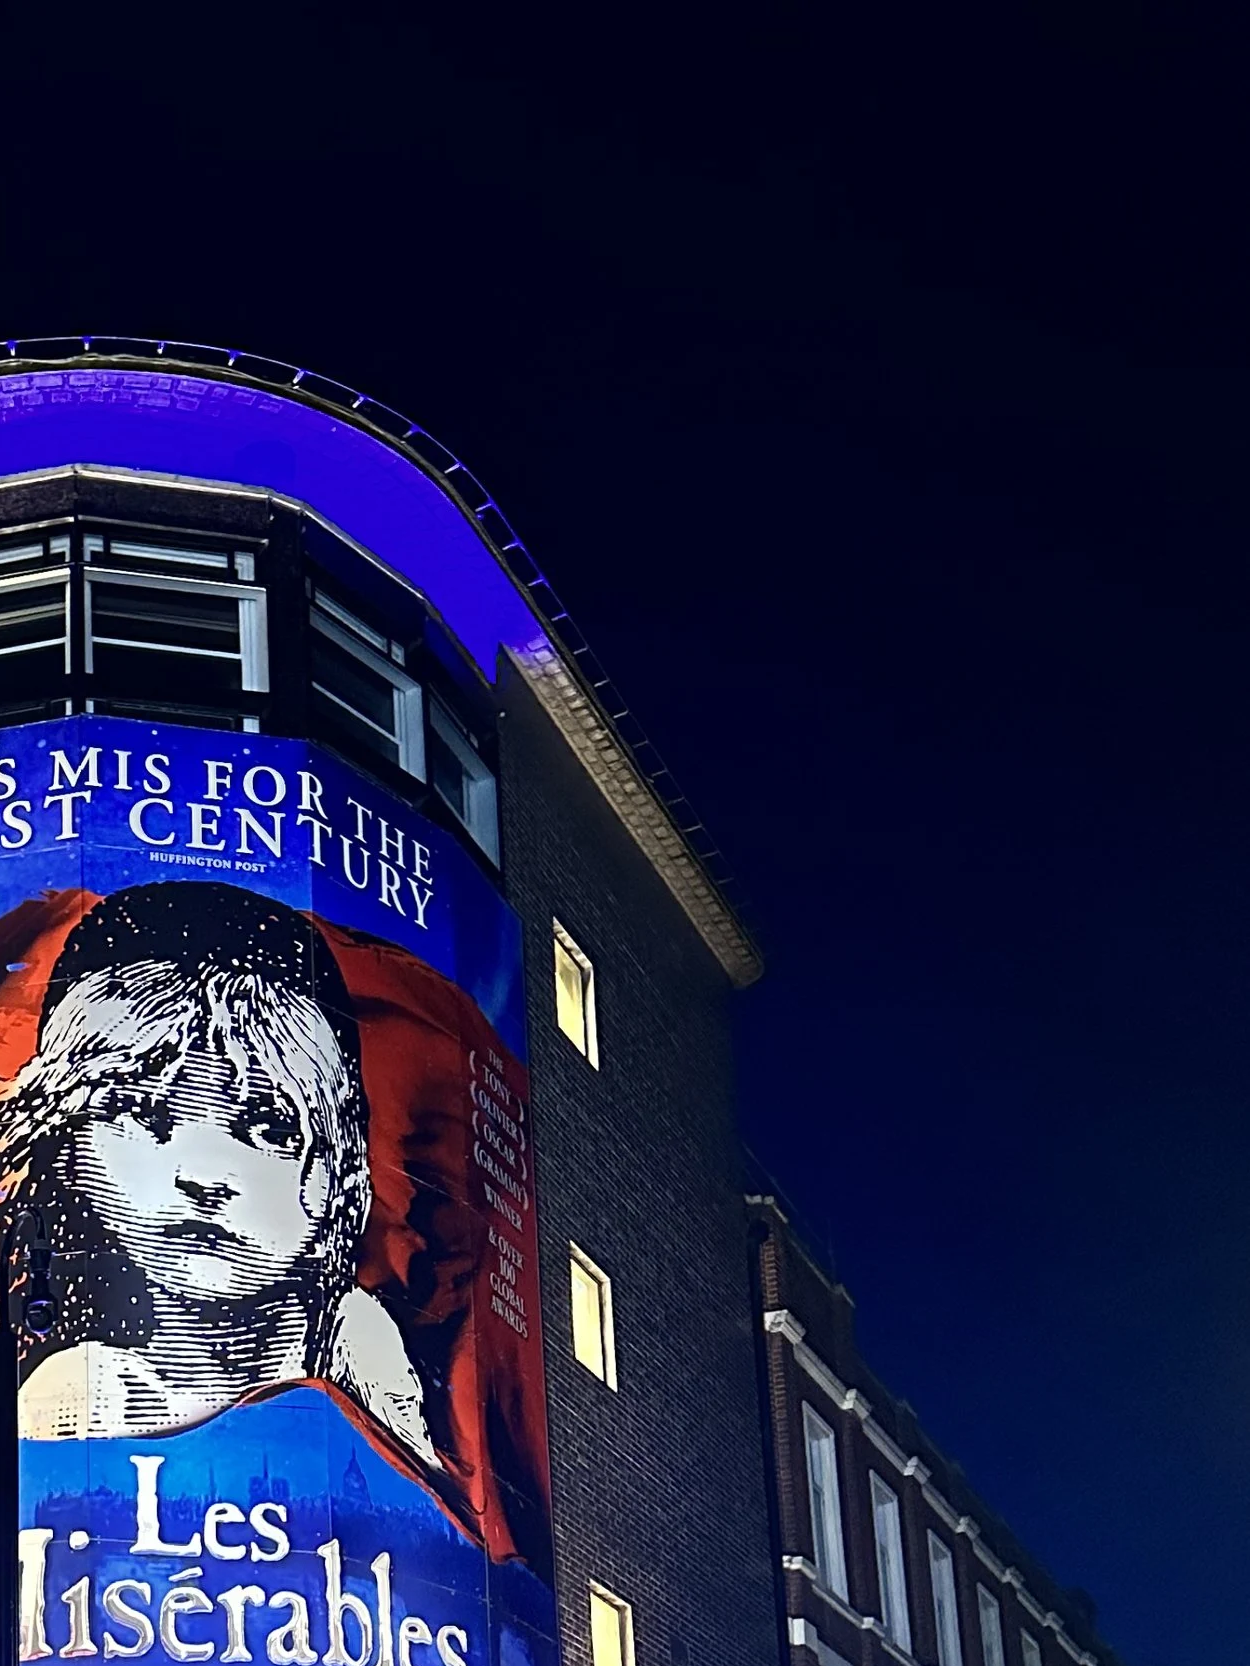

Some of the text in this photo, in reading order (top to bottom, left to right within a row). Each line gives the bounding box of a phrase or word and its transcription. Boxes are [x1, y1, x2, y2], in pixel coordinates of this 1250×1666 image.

[48, 746, 171, 795] MIS
[203, 759, 328, 820] FOR
[347, 797, 434, 885] THE
[128, 797, 434, 930] CENTURY
[149, 851, 268, 874] HUFFINGTON POST
[488, 1047, 504, 1075] THE
[482, 1064, 512, 1106] TONY
[478, 1089, 519, 1144] OLIVIER
[483, 1123, 517, 1169] OSCAR
[479, 1149, 525, 1203] GRAMMY
[483, 1181, 524, 1233] WINNER
[488, 1226, 525, 1272] & OVER
[498, 1255, 516, 1286] 100
[489, 1271, 528, 1318] GLOBAL
[490, 1294, 529, 1339] AWARDS
[128, 1454, 290, 1563] Les
